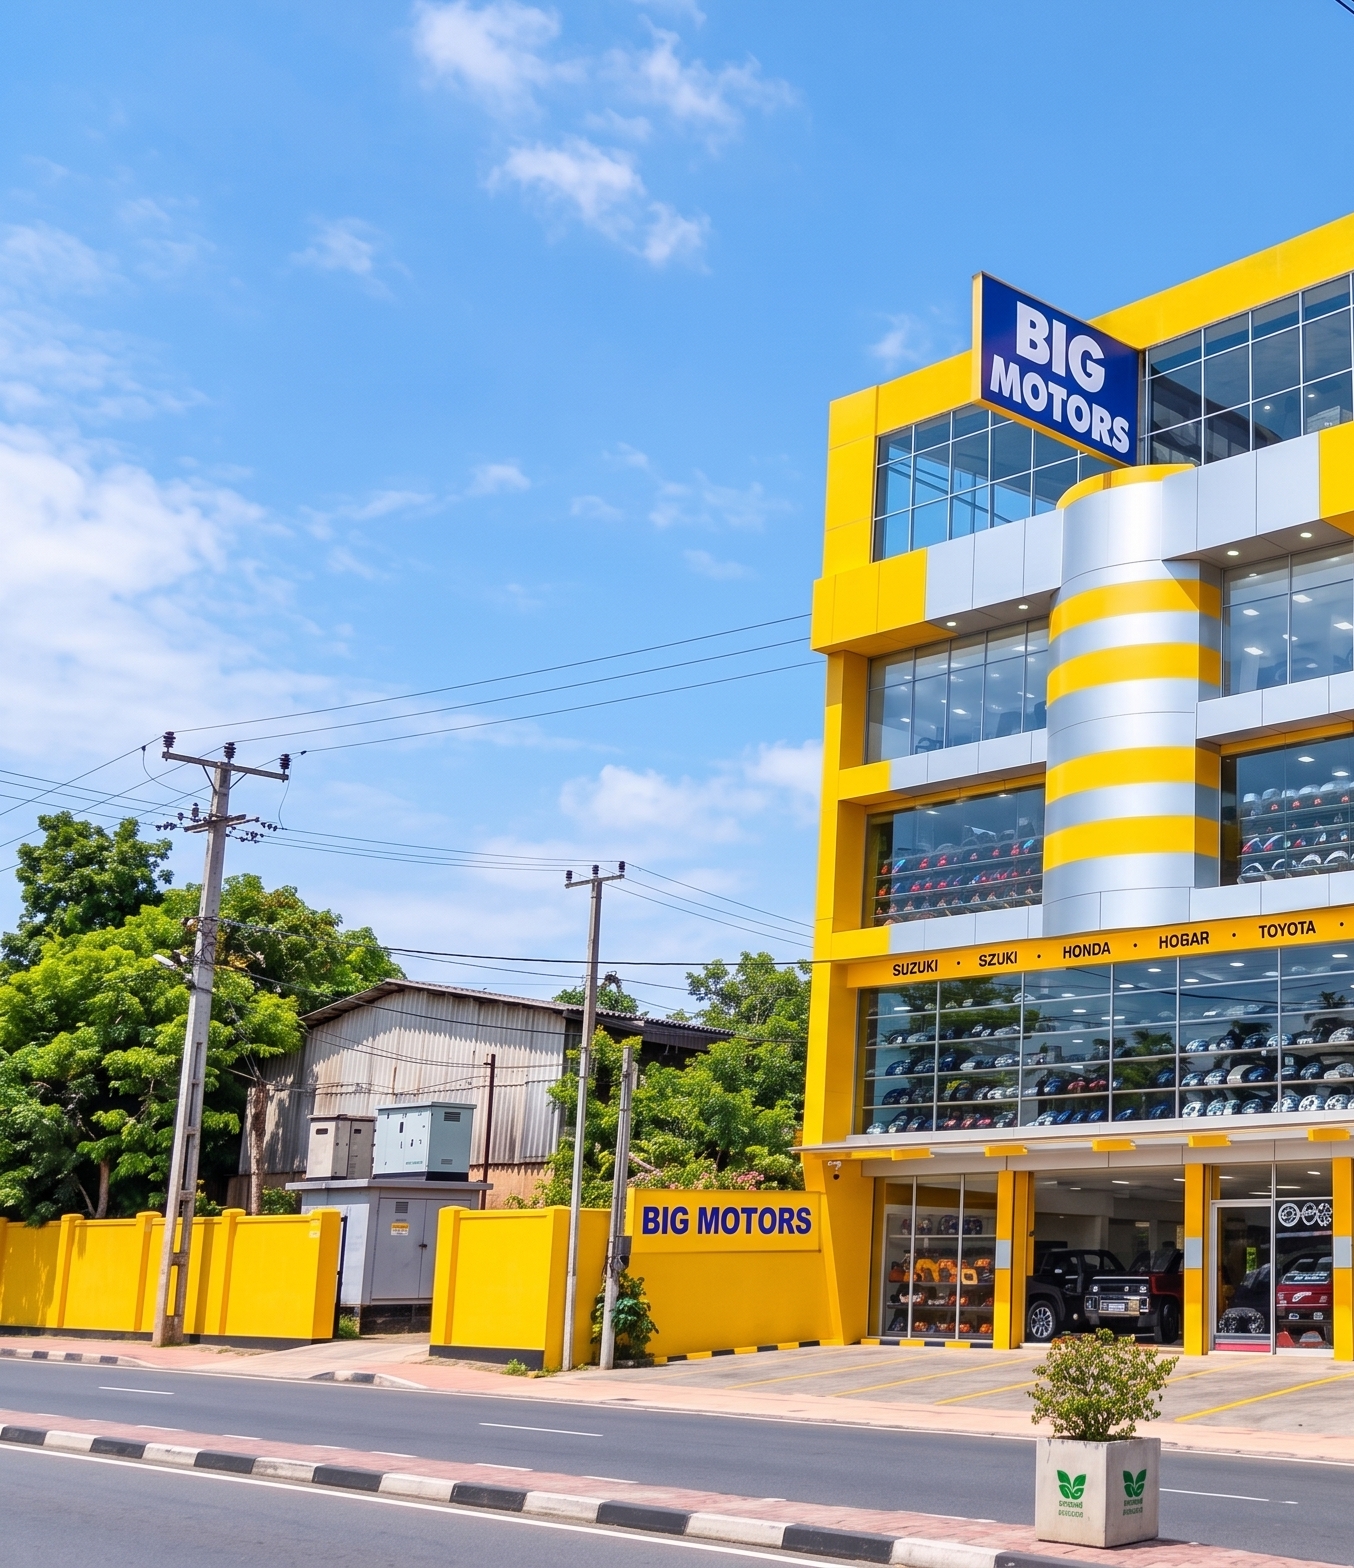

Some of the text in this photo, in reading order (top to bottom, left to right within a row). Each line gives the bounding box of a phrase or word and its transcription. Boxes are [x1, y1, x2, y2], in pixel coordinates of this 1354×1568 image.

[1016, 301, 1105, 393] BIG
[990, 354, 1130, 454] MOTORS
[893, 959, 939, 977] SUZUKI
[978, 951, 1018, 967] SZUKI
[1063, 942, 1111, 959] HONDA
[1159, 931, 1210, 949] HOGAR
[1259, 920, 1316, 939] TOYOTA
[642, 1206, 812, 1235] BIG MOTORS
